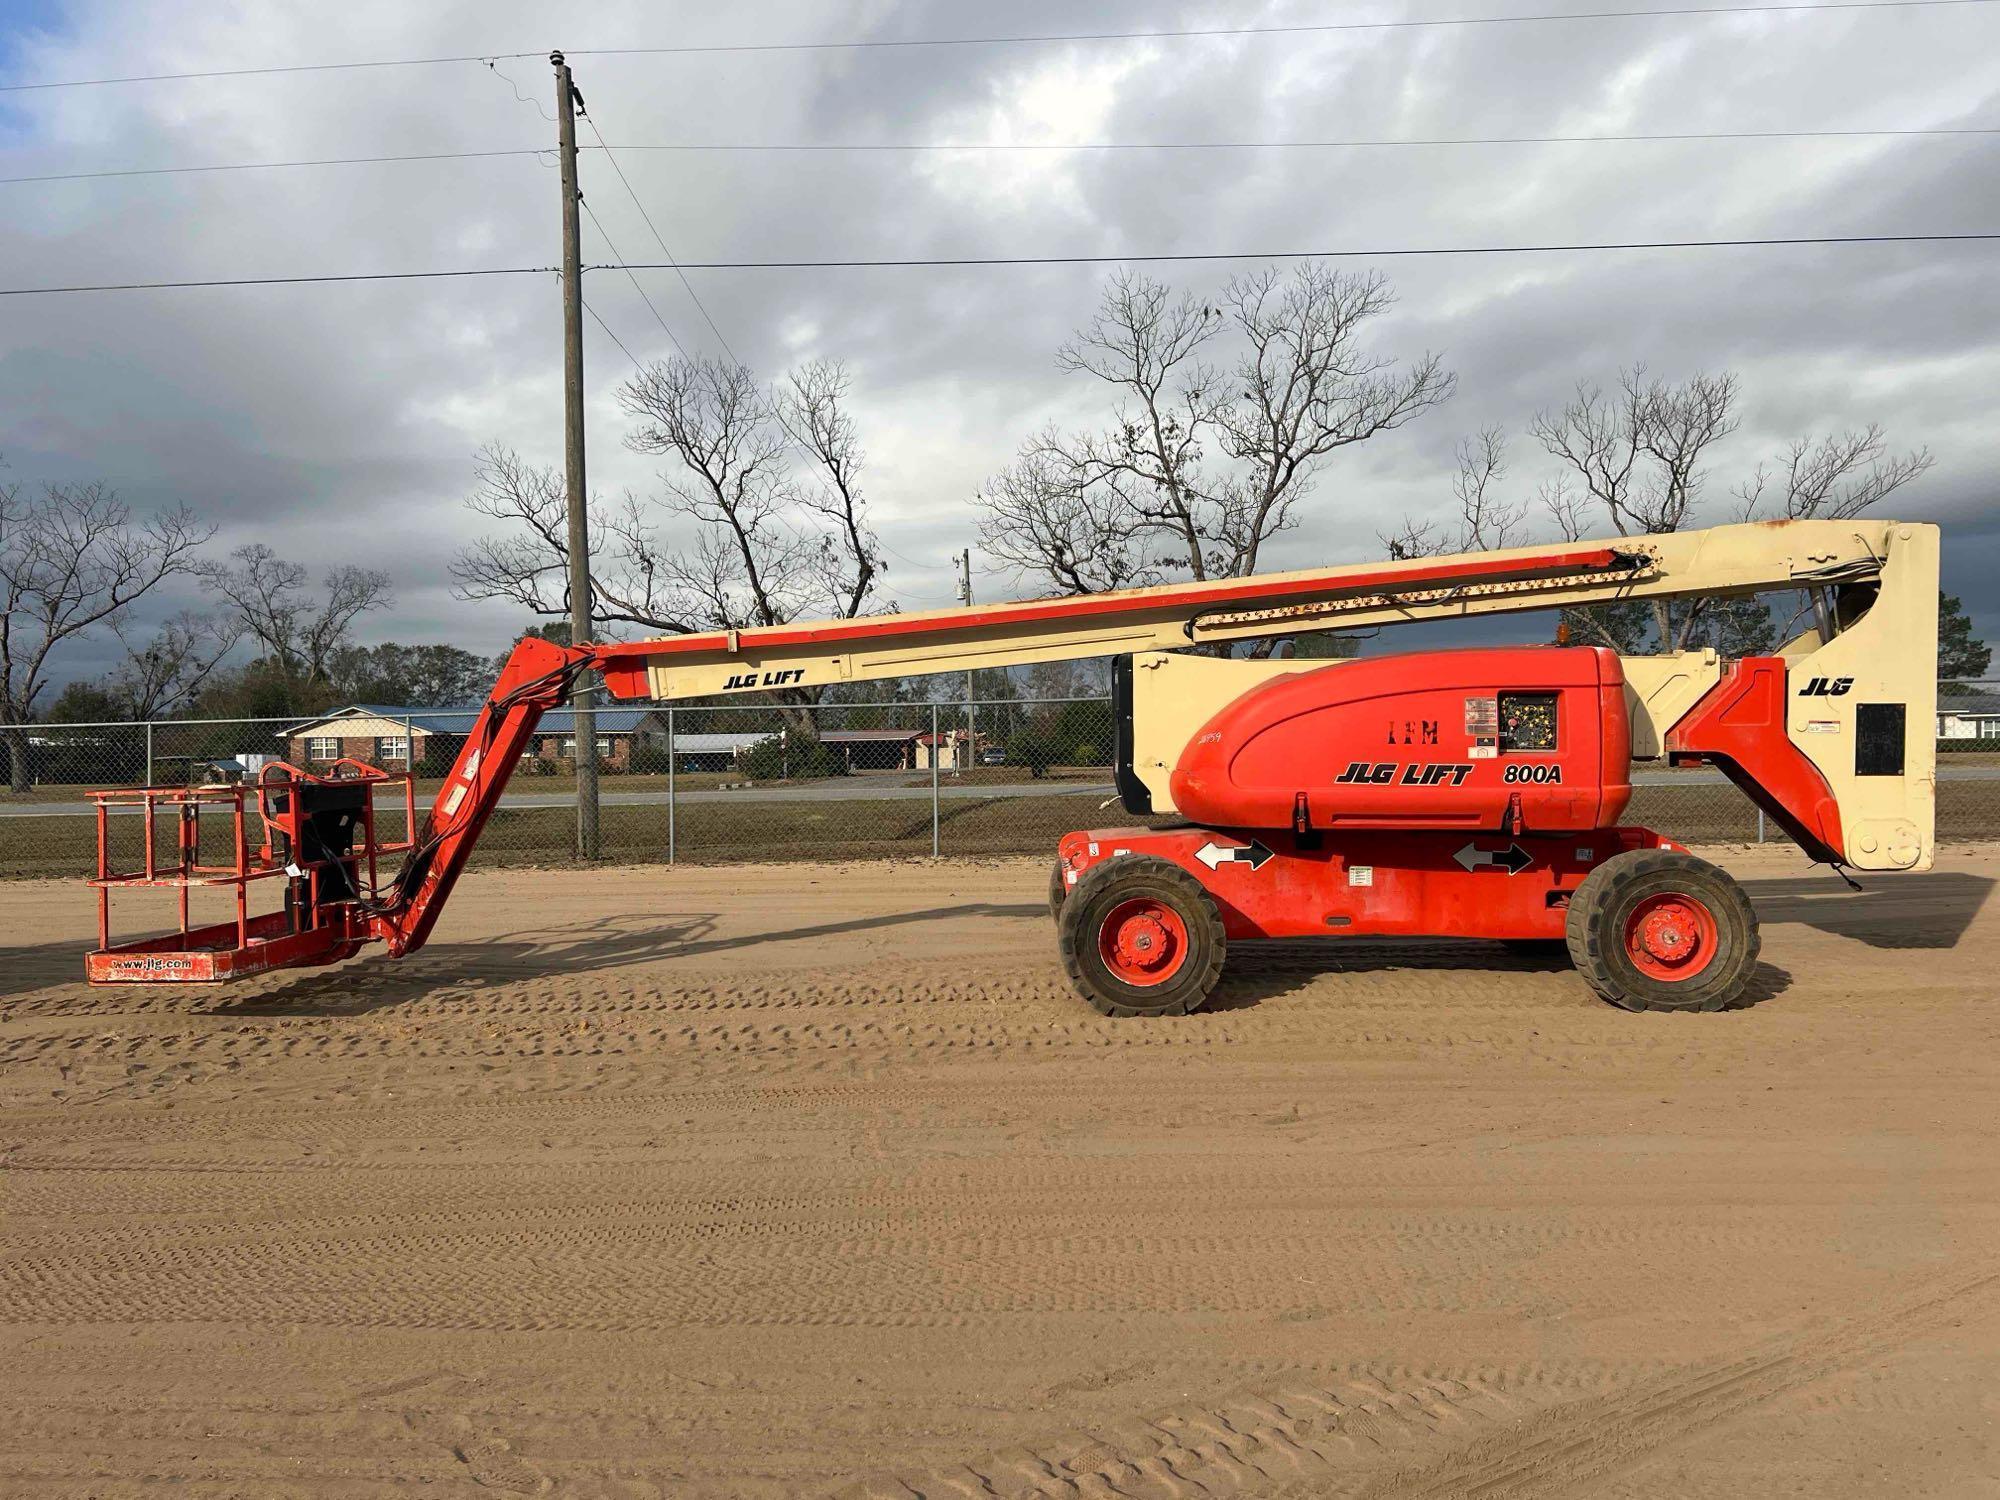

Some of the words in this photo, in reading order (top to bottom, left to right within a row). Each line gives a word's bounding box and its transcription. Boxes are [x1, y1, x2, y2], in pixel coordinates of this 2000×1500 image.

[722, 674, 758, 690] JLG
[762, 669, 805, 686] LIFT
[1798, 677, 1854, 696] JLG
[1334, 763, 1398, 785] JLG
[1400, 763, 1474, 786] LIFT
[1504, 764, 1562, 784] 800A
[113, 958, 192, 971] www.jlg.com
